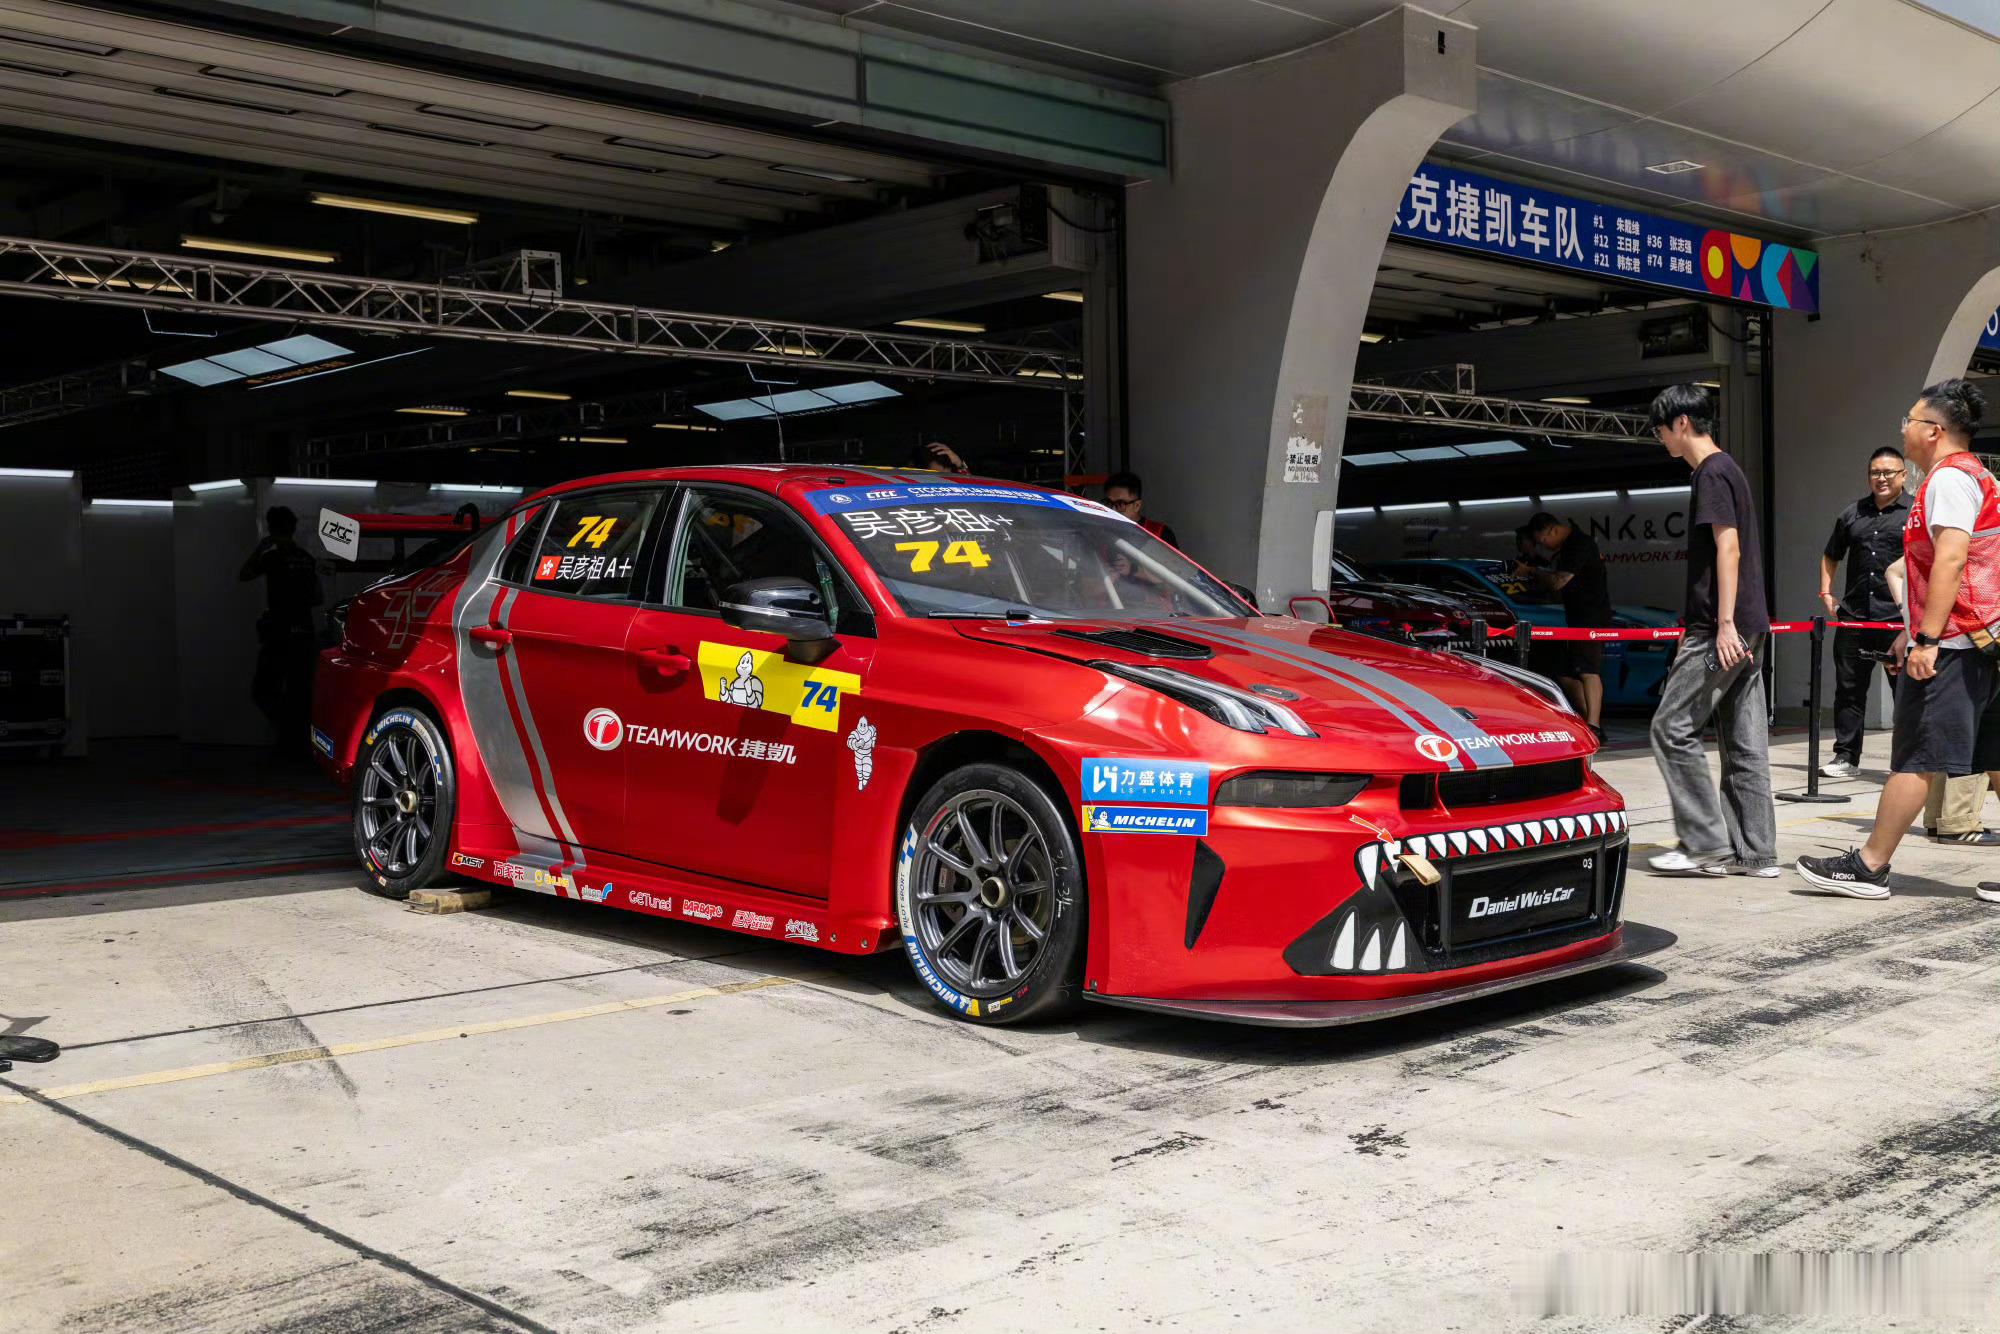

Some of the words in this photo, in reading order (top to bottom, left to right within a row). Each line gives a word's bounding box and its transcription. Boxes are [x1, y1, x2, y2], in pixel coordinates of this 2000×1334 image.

[1395, 173, 1584, 262] 克捷凯车队
[1593, 215, 1604, 229] #1
[1593, 234, 1609, 249] #12
[1647, 234, 1662, 249] #36
[1669, 235, 1692, 254] 张志强
[1594, 253, 1610, 268] #21
[1617, 254, 1640, 273] 韩东君
[1647, 253, 1662, 268] #74
[1669, 256, 1692, 275] 吴彦祖
[566, 515, 618, 549] 74
[842, 507, 996, 539] 吴彦祖
[895, 540, 992, 573] 74
[556, 555, 606, 580] 吴彦祖
[604, 557, 632, 578] A+
[801, 680, 839, 713] 74
[377, 714, 412, 732] MICHELIN
[626, 723, 738, 757] TEAMWORK
[1453, 731, 1540, 750] TEAMWORK
[1120, 770, 1194, 788] 力盛体育
[1142, 788, 1192, 796] SPORTS
[1113, 815, 1196, 828] MICHELIN
[453, 853, 485, 869] CMST
[1582, 858, 1593, 870] 03
[1831, 872, 1856, 880] HOKA
[1468, 896, 1520, 918] Daniel
[1520, 889, 1553, 909] Wu's
[1551, 887, 1575, 902] Car
[901, 903, 909, 928] PILOT
[907, 942, 958, 1005] MICHELIN
